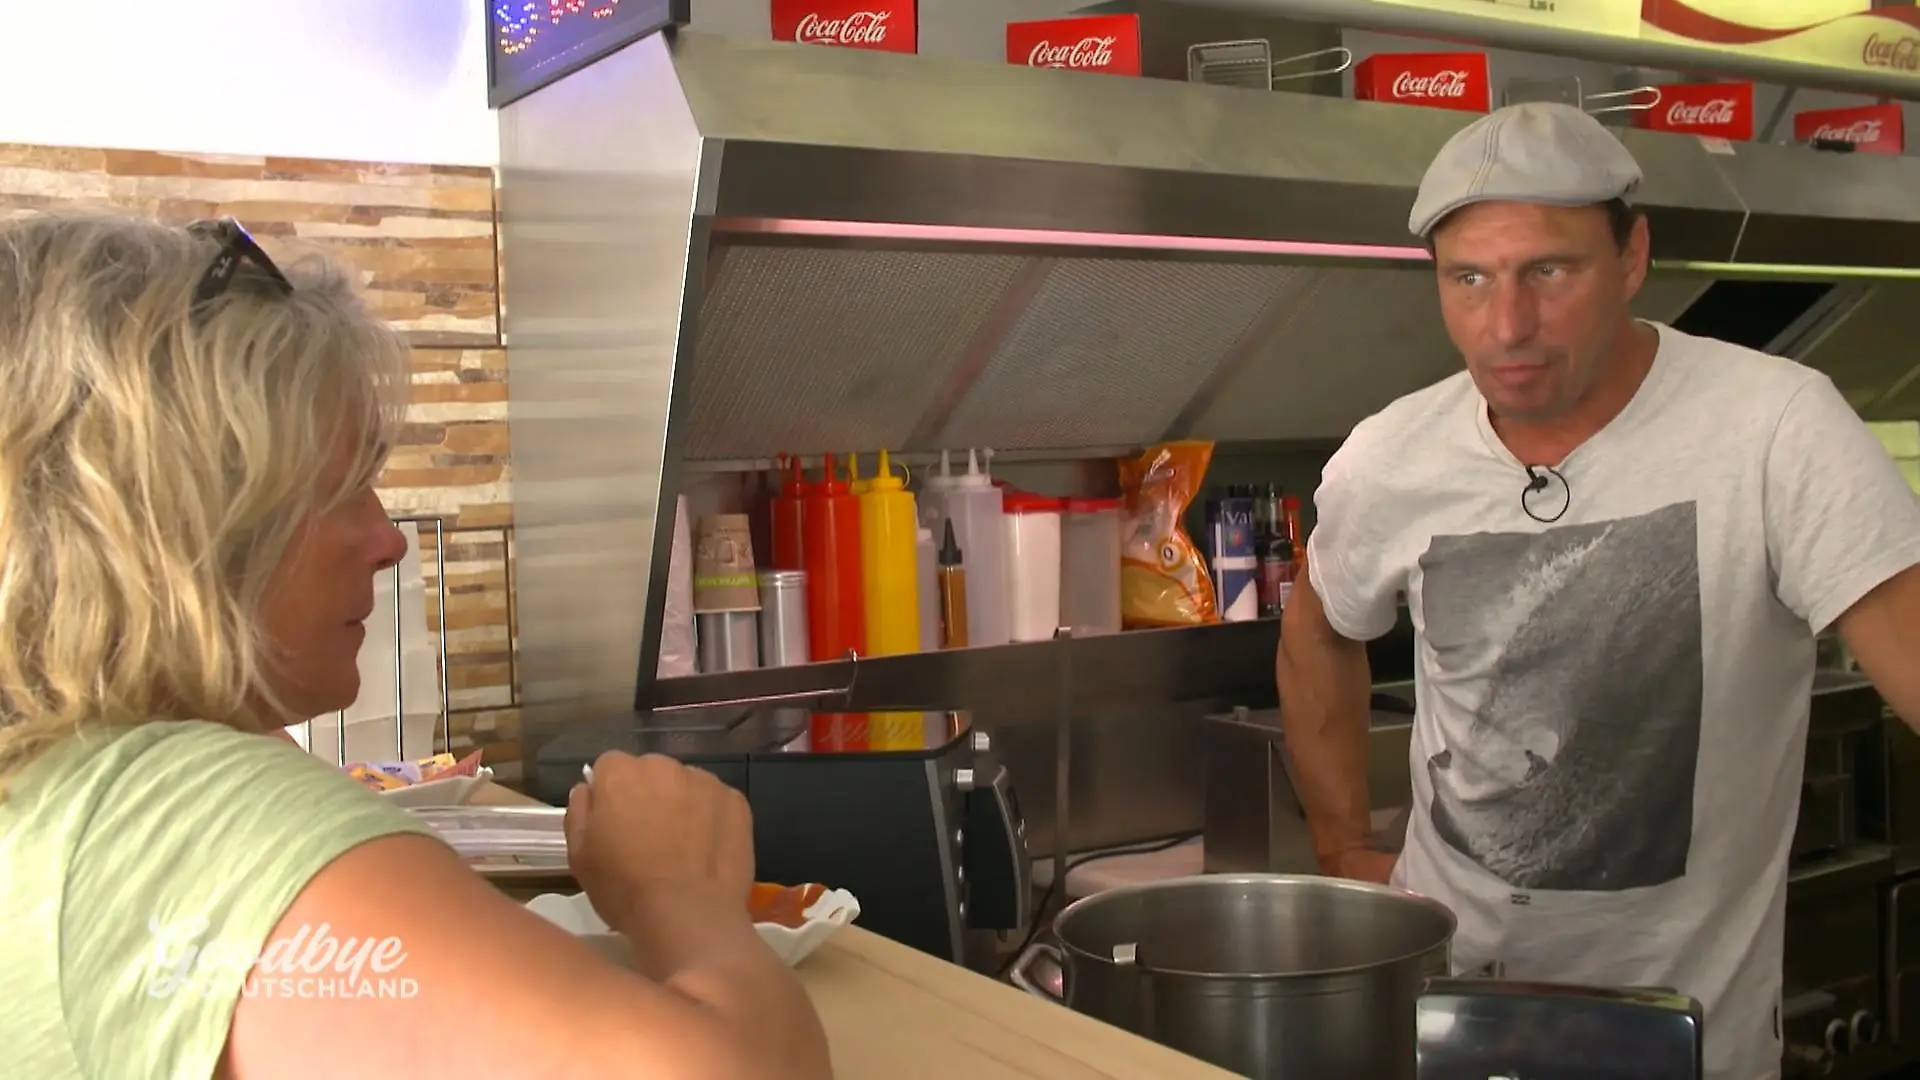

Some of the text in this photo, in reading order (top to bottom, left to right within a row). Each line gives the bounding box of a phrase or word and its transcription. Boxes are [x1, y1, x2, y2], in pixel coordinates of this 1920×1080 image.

[795, 10, 892, 44] Coca-Cola
[1028, 36, 1116, 68] Coca-Cola
[1392, 70, 1469, 98] Coca-Cola
[1666, 99, 1737, 125] Coca-Cola
